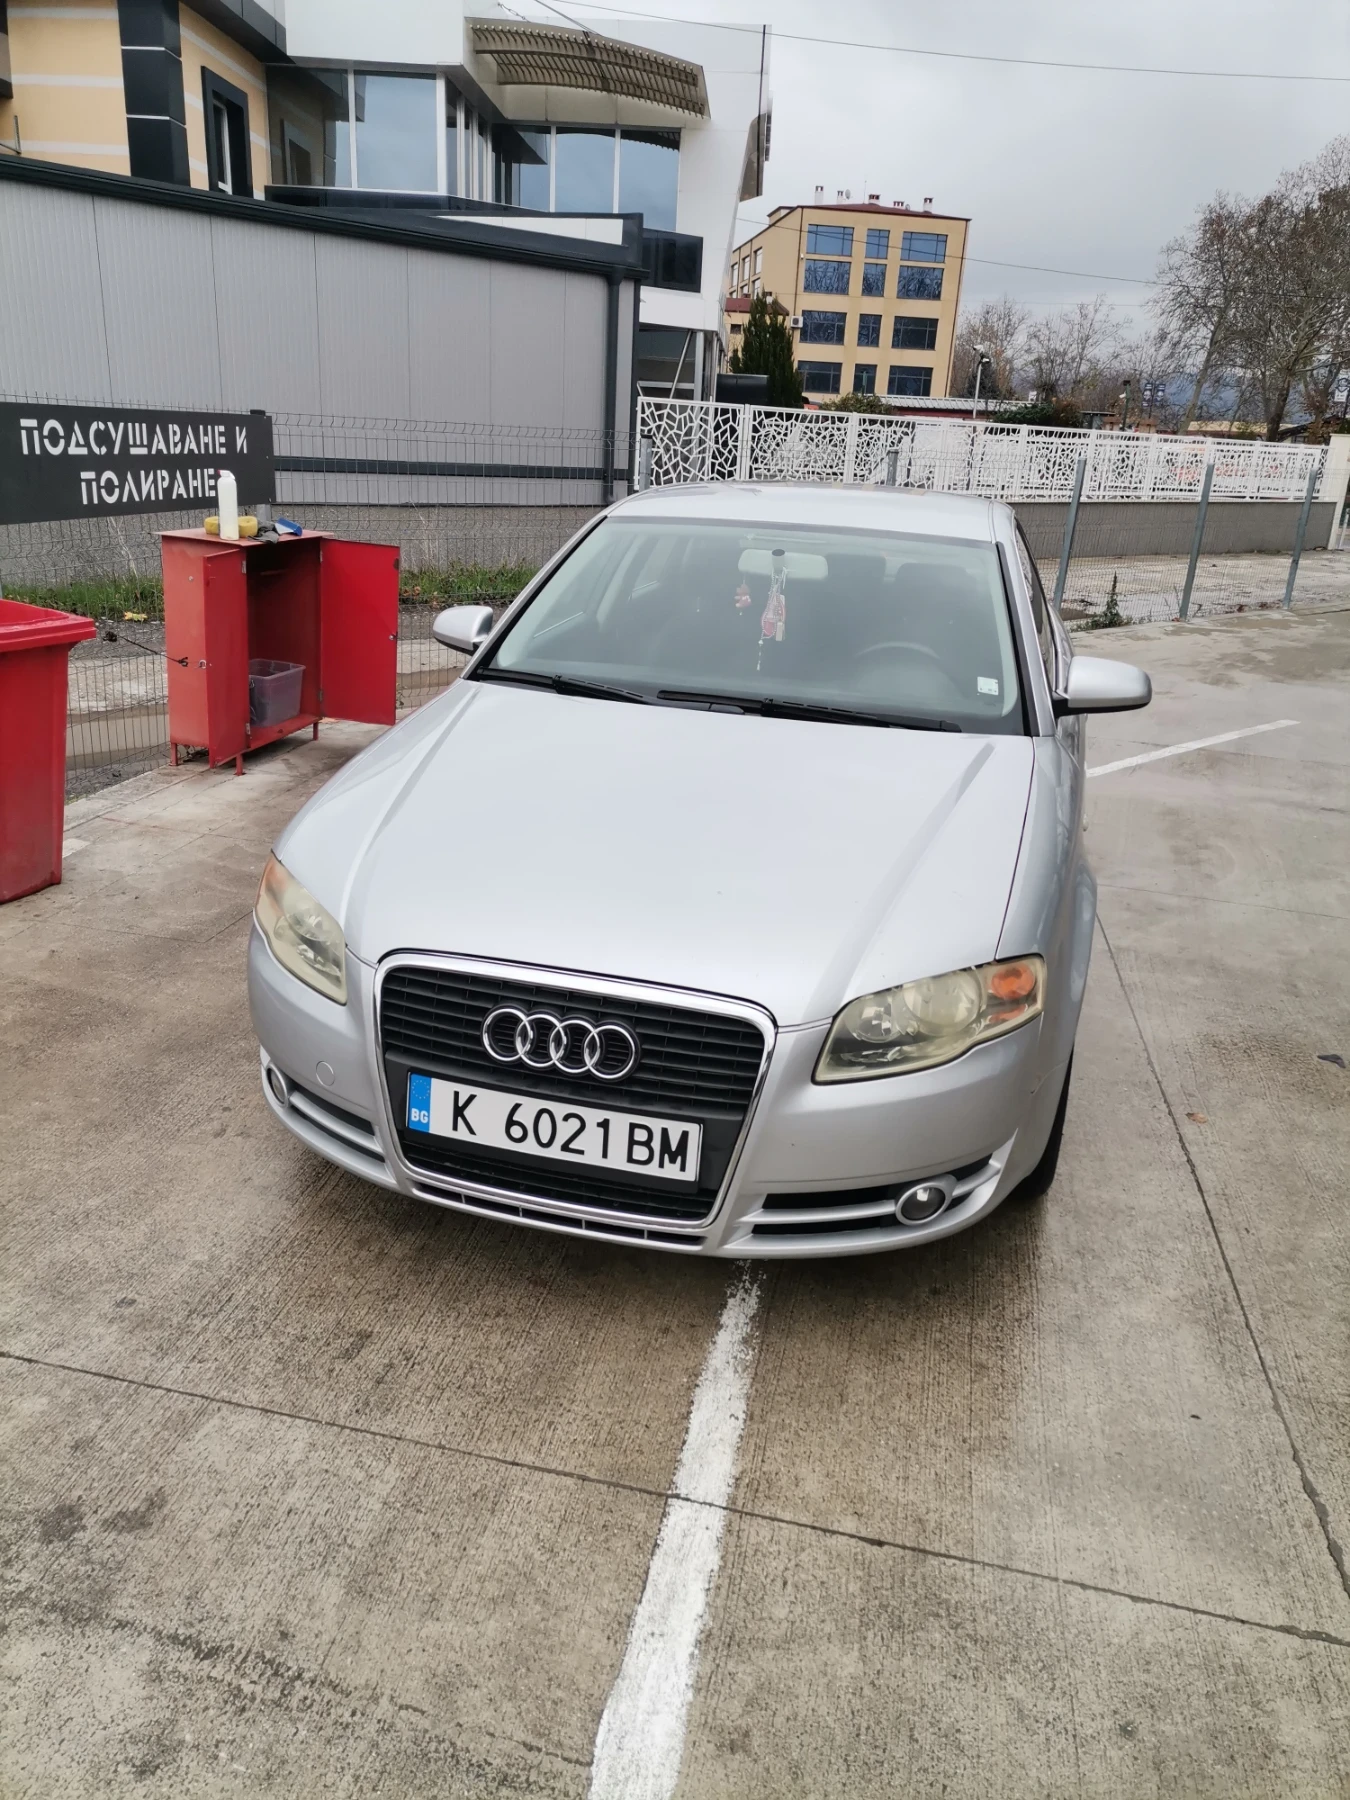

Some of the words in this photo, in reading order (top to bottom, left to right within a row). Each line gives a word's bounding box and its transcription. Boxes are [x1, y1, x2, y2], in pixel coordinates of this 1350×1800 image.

[20, 418, 227, 456] ПОДСУШАВАНЕ
[235, 425, 248, 454] И
[80, 468, 216, 505] ПОЛИРАНЕ
[410, 1107, 429, 1124] BG
[452, 1090, 478, 1136] K
